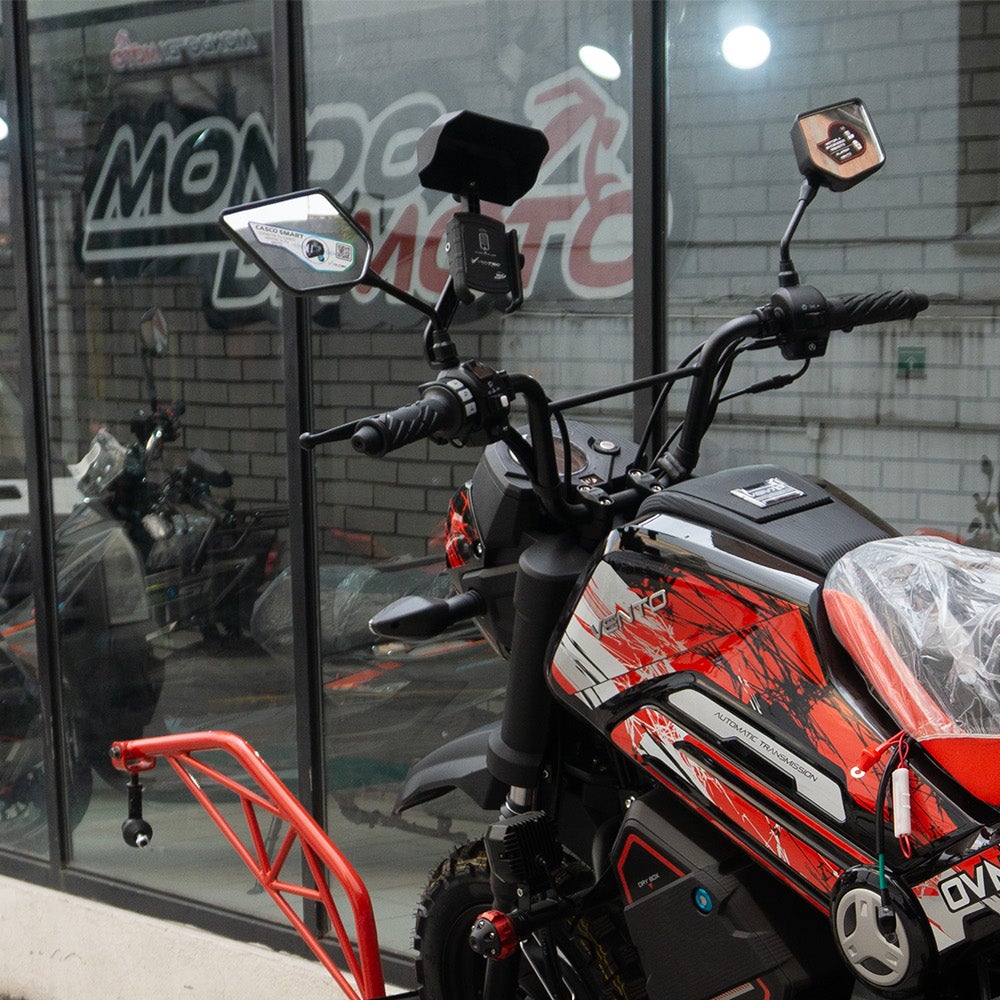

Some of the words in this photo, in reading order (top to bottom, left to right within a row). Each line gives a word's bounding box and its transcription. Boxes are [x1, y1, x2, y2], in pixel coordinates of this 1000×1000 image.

[590, 589, 668, 640] VENTO
[713, 711, 758, 742] AUTOMATIC
[758, 740, 818, 783] TRANSMISSION
